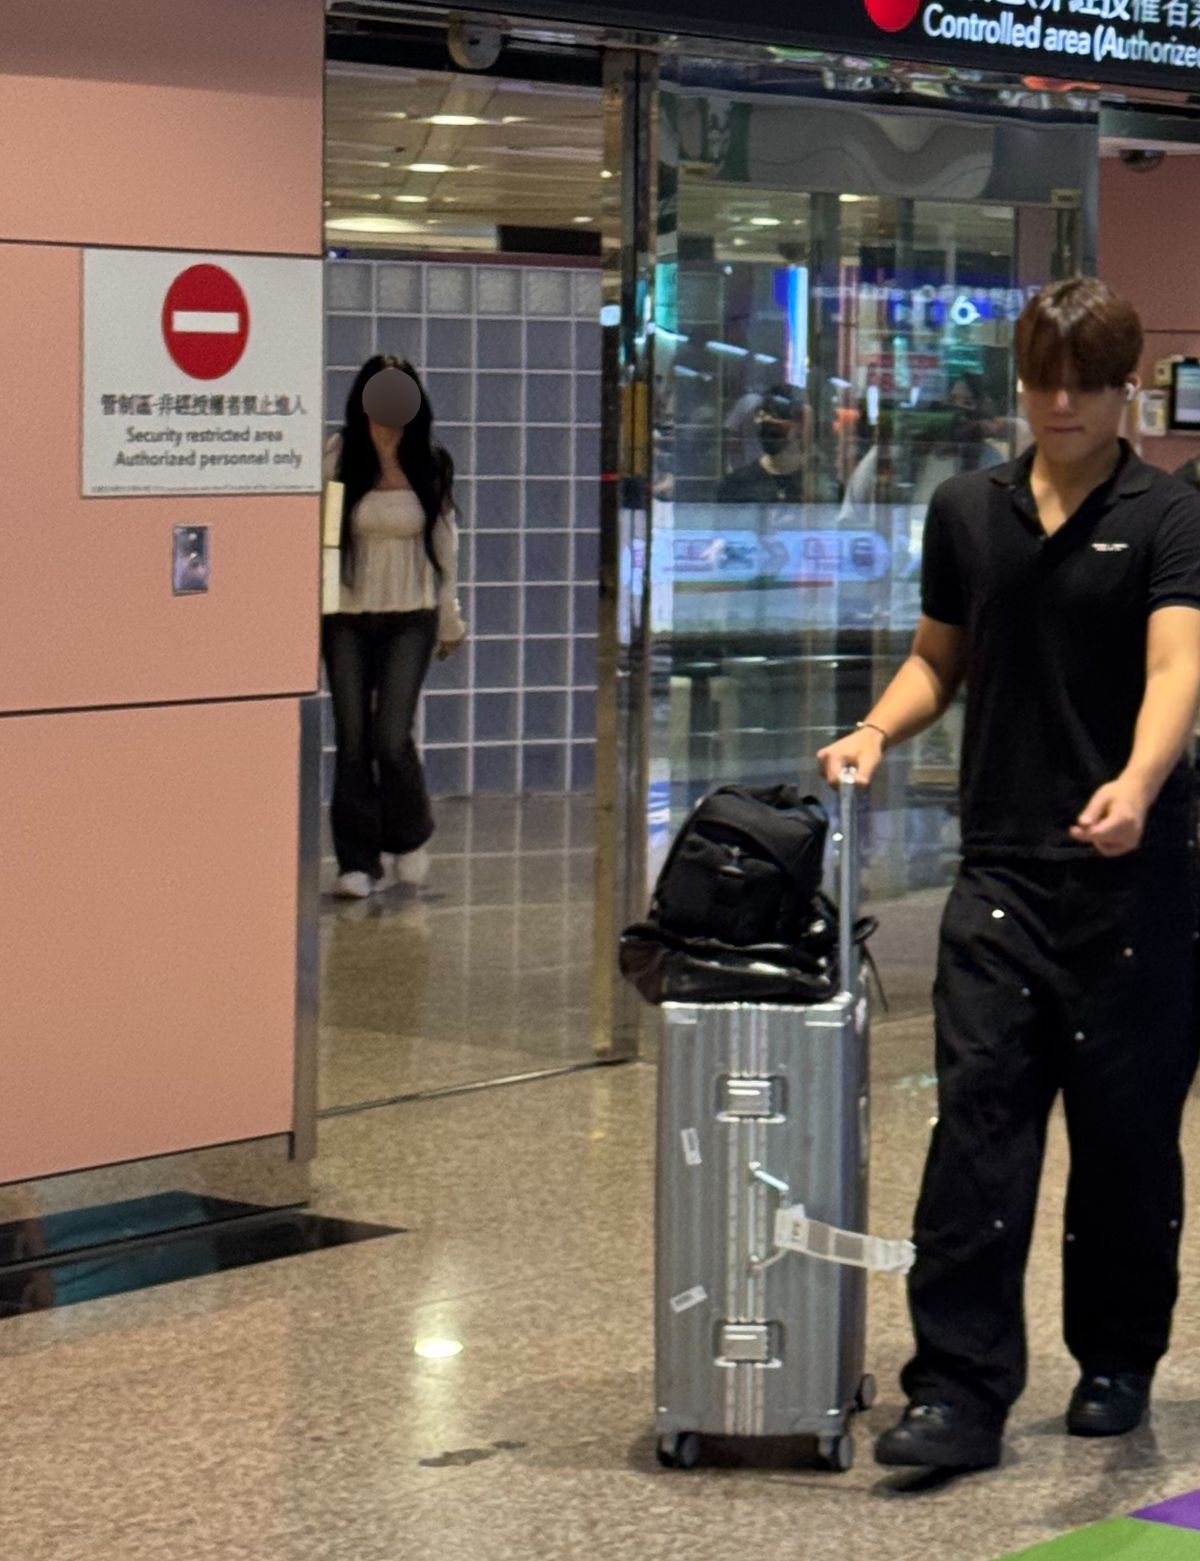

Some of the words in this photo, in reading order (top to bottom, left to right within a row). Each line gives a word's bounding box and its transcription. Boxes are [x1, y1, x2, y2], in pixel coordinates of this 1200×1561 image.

[922, 2, 1042, 49] Controlled
[1043, 26, 1092, 56] area
[125, 425, 183, 447] Security
[186, 426, 251, 443] restricted
[253, 429, 284, 443] area
[114, 450, 197, 467] Authorized
[199, 449, 269, 470] personnel
[272, 448, 303, 469] only
